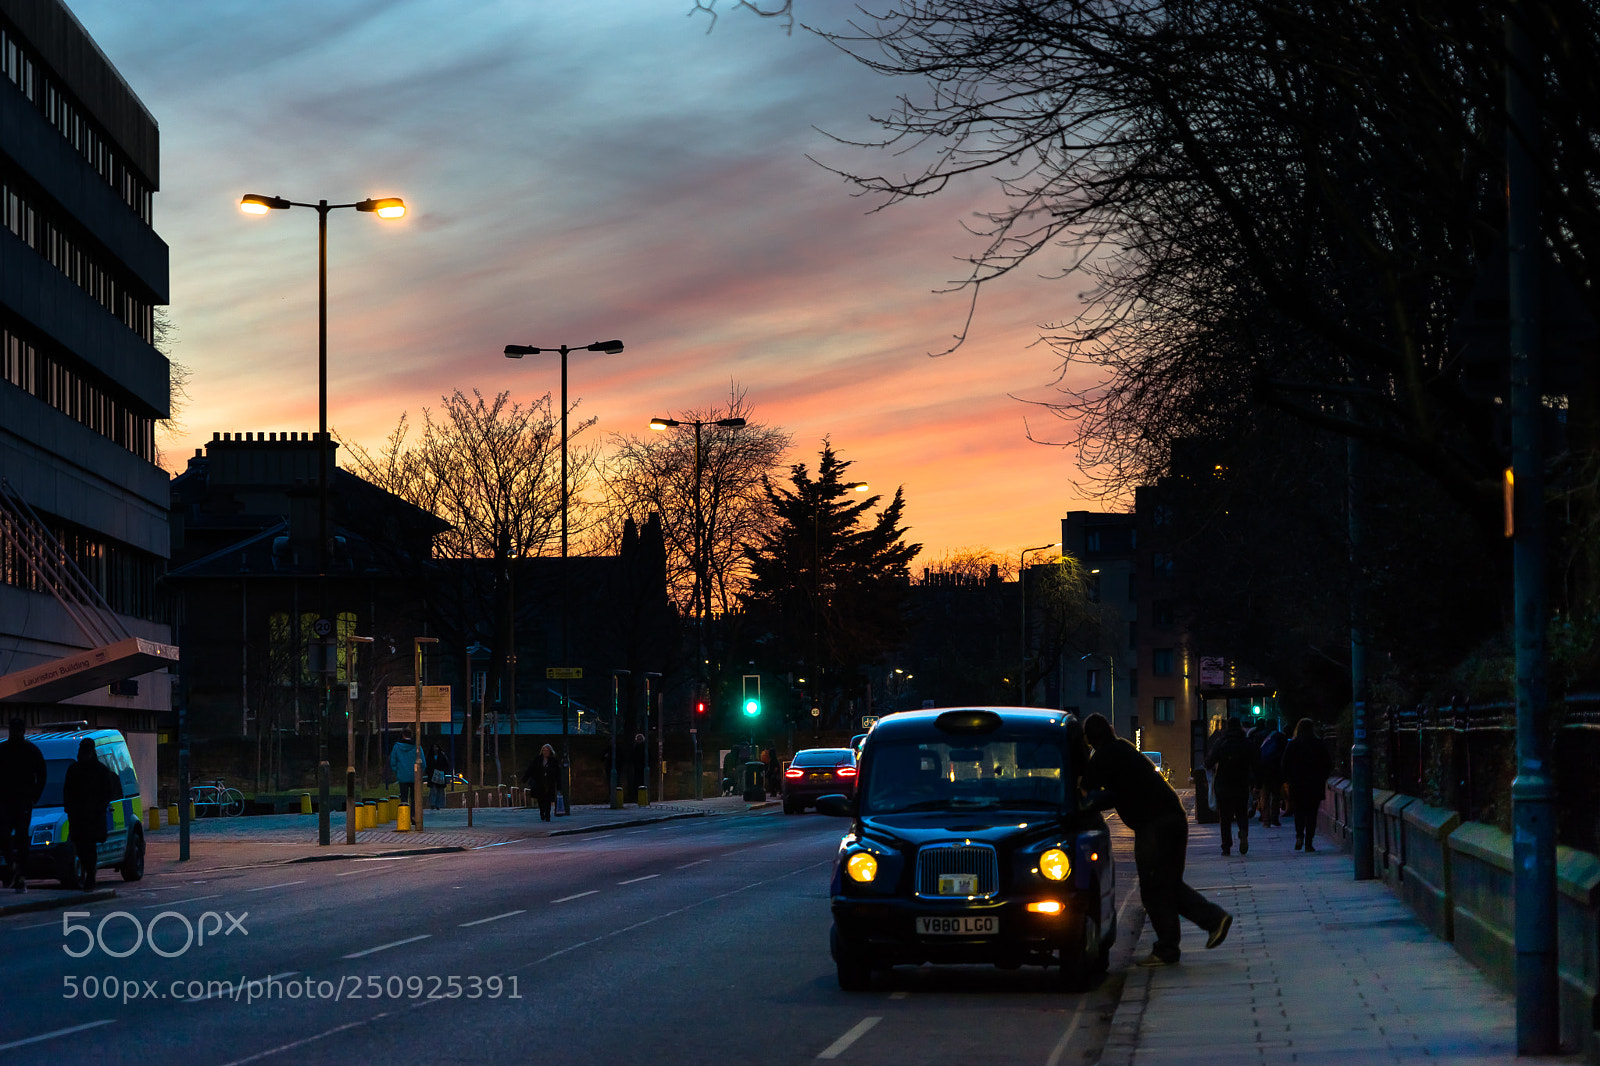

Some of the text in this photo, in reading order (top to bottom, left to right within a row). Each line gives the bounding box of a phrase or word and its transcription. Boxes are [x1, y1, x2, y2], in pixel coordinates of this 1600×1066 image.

[317, 622, 330, 631] 20
[23, 658, 90, 687] Lauriston Building
[922, 918, 993, 932] V880 LGO
